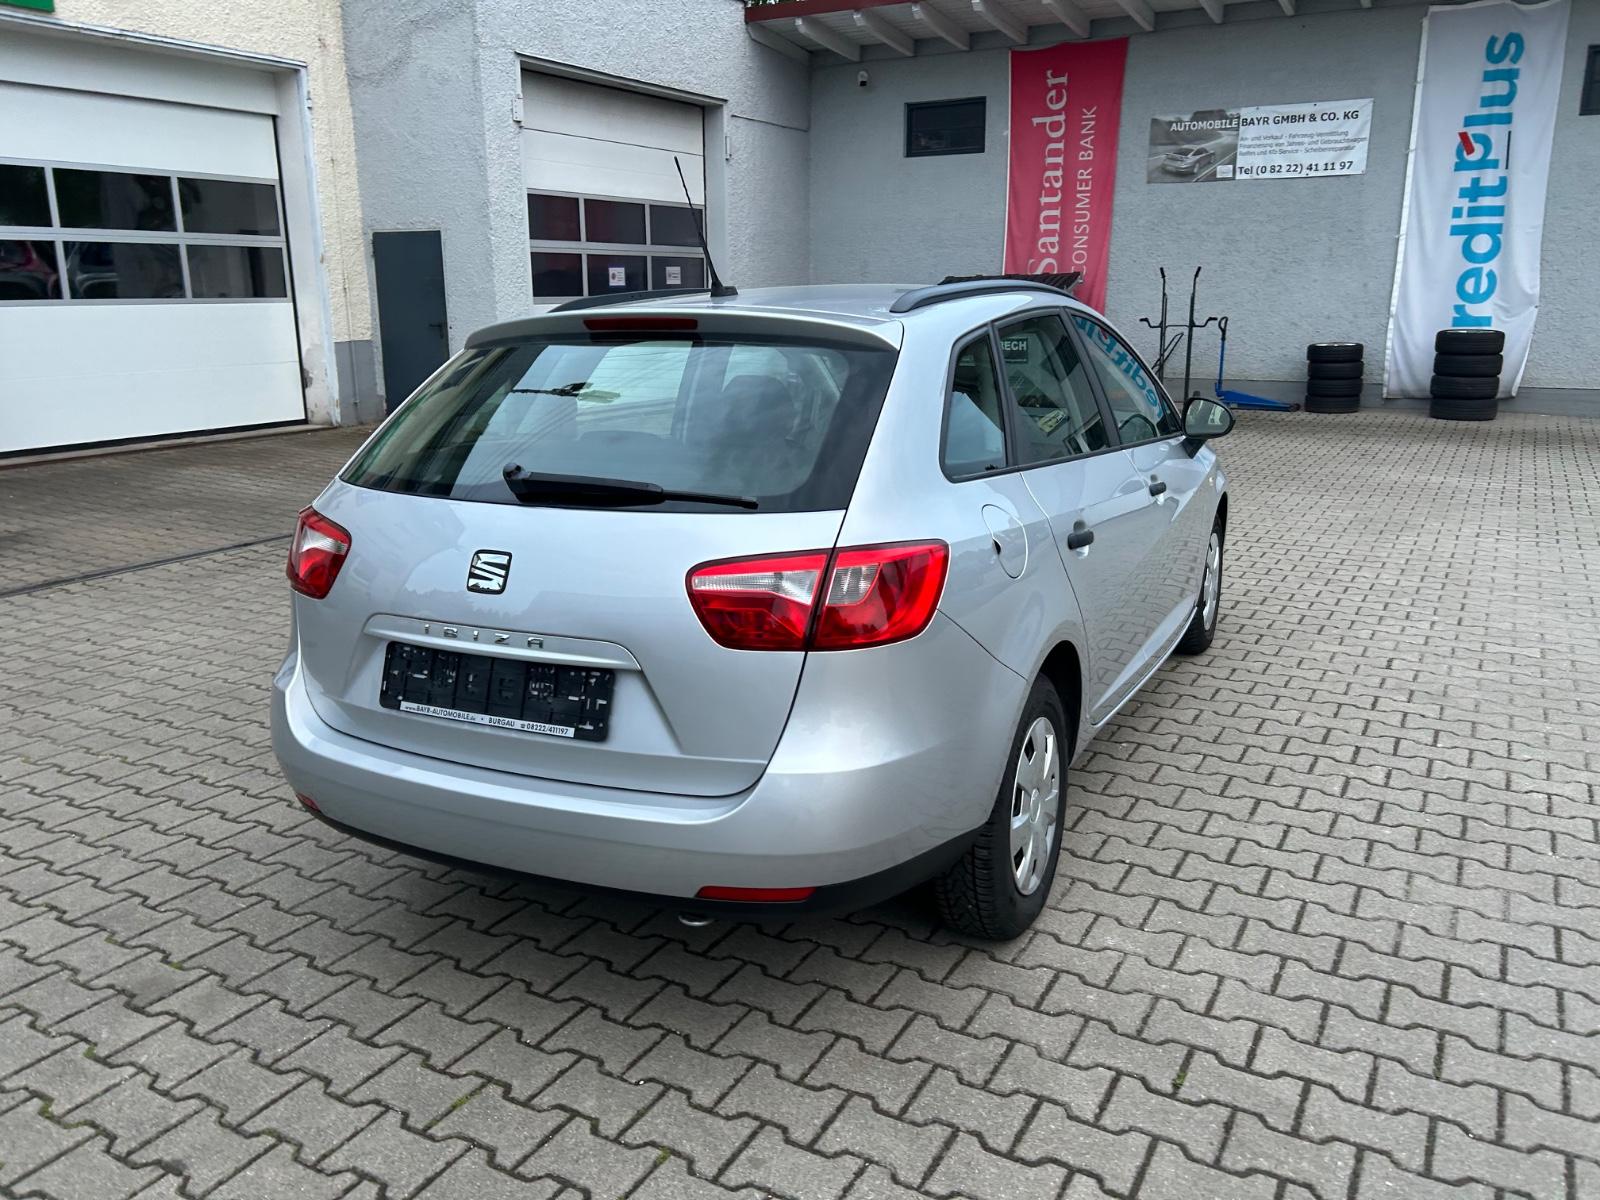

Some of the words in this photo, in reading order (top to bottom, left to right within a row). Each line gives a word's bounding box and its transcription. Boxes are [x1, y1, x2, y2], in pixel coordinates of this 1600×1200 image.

[1079, 105, 1097, 161] BANK
[1170, 119, 1239, 132] AUTOMOBILE
[1241, 116, 1270, 127] BAYR
[1273, 114, 1306, 125] GMBH
[1309, 113, 1318, 122] &
[1320, 112, 1340, 121] CO.
[1343, 110, 1360, 120] KG
[1027, 70, 1069, 274] Santander
[1238, 166, 1253, 175] Tel
[1256, 165, 1267, 175] (0
[1269, 164, 1283, 174] 82
[1285, 163, 1303, 174] 22)
[1306, 163, 1320, 172] 41
[1323, 162, 1336, 171] 11
[1339, 160, 1354, 170] 97
[405, 704, 476, 721] www.BAYR-AUTOMOBILE.de
[488, 717, 515, 728] BURGAU
[526, 723, 569, 735] 08222/411197
